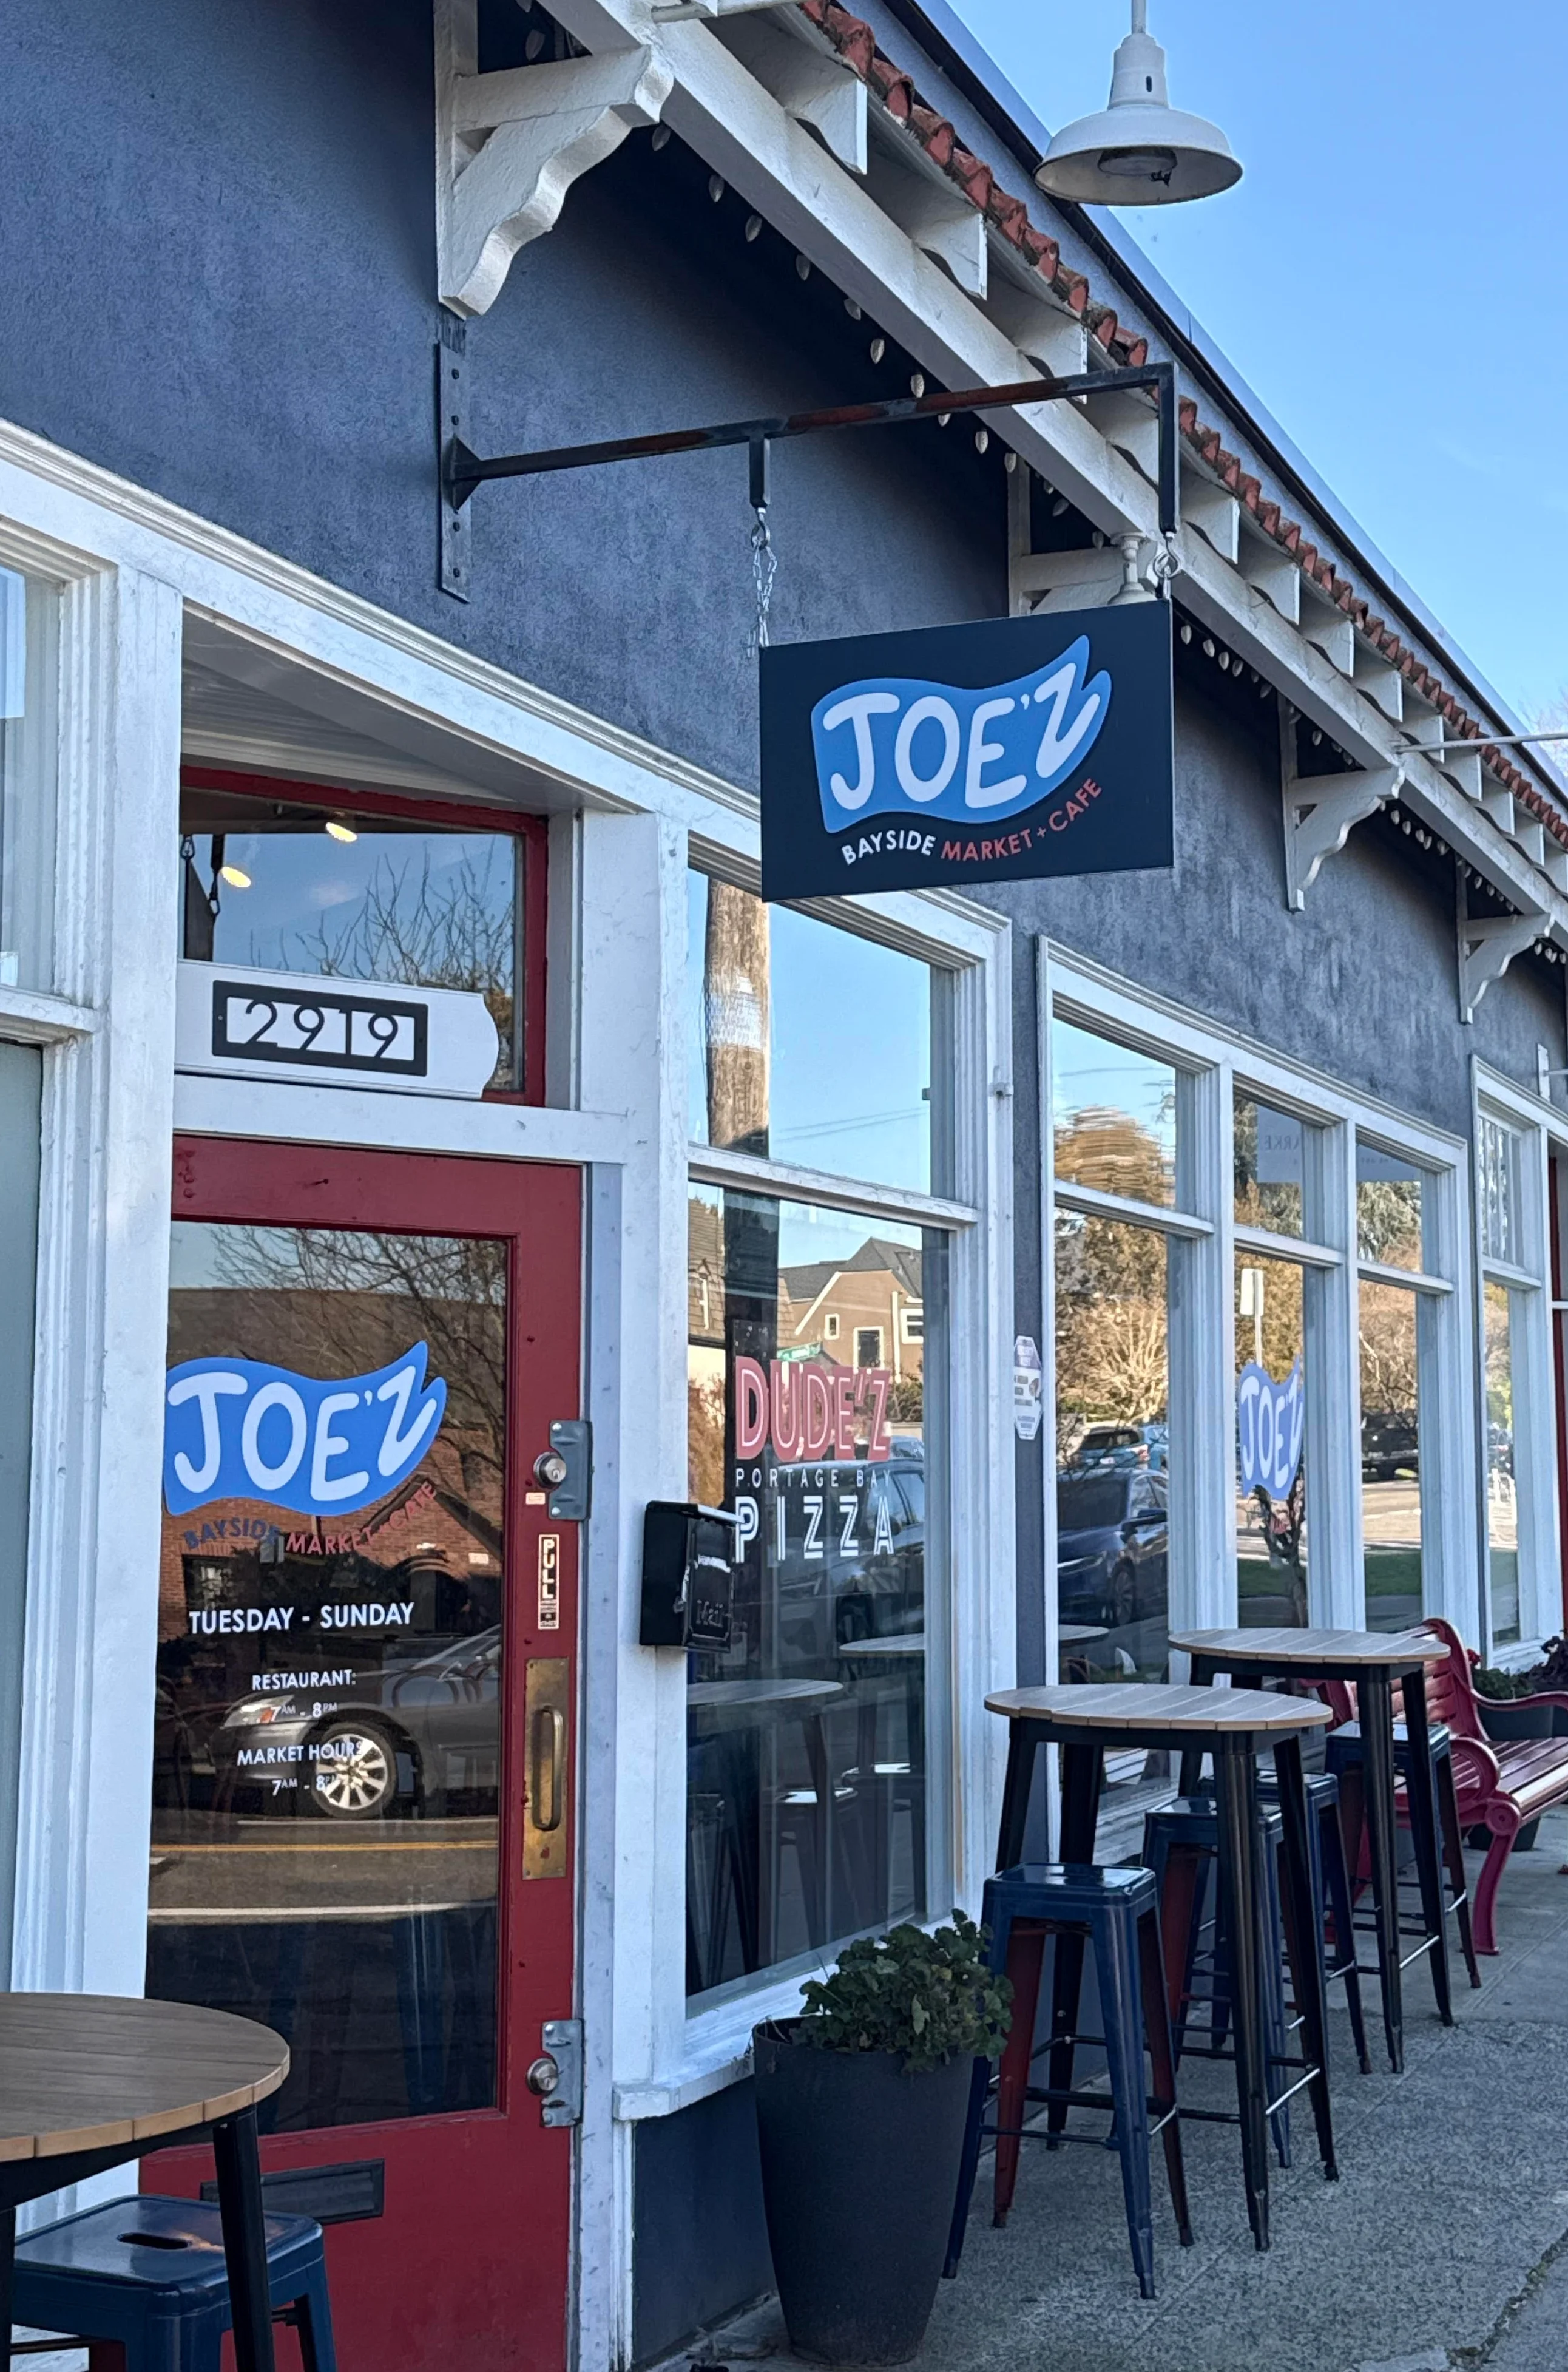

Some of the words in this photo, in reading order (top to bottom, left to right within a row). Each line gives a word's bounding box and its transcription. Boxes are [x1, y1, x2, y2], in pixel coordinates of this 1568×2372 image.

[822, 662, 1100, 810] JOE'Z
[842, 829, 936, 865] BAYSIDE
[941, 828, 1032, 862] MARKET
[1048, 778, 1103, 832] CAFE
[245, 999, 398, 1059] 2919
[167, 1366, 438, 1502] JOE'Z
[735, 1355, 891, 1462] DUDE'Z
[735, 1467, 839, 1488] PORTAGE
[856, 1468, 891, 1488] BAY
[183, 1517, 282, 1550] BAYSIDE
[285, 1525, 374, 1555] MARKET
[388, 1481, 438, 1528] CAFE
[735, 1495, 894, 1564] PIZZA
[542, 1538, 556, 1599] PULL
[189, 1606, 295, 1635] TUESDAY
[320, 1601, 415, 1628] SUNDAY
[252, 1669, 357, 1691] RESTAURANT:
[270, 1705, 296, 1722] 7AM
[313, 1701, 337, 1718] 8PM
[237, 1745, 305, 1767] MARKET
[272, 1778, 298, 1797] 7AM
